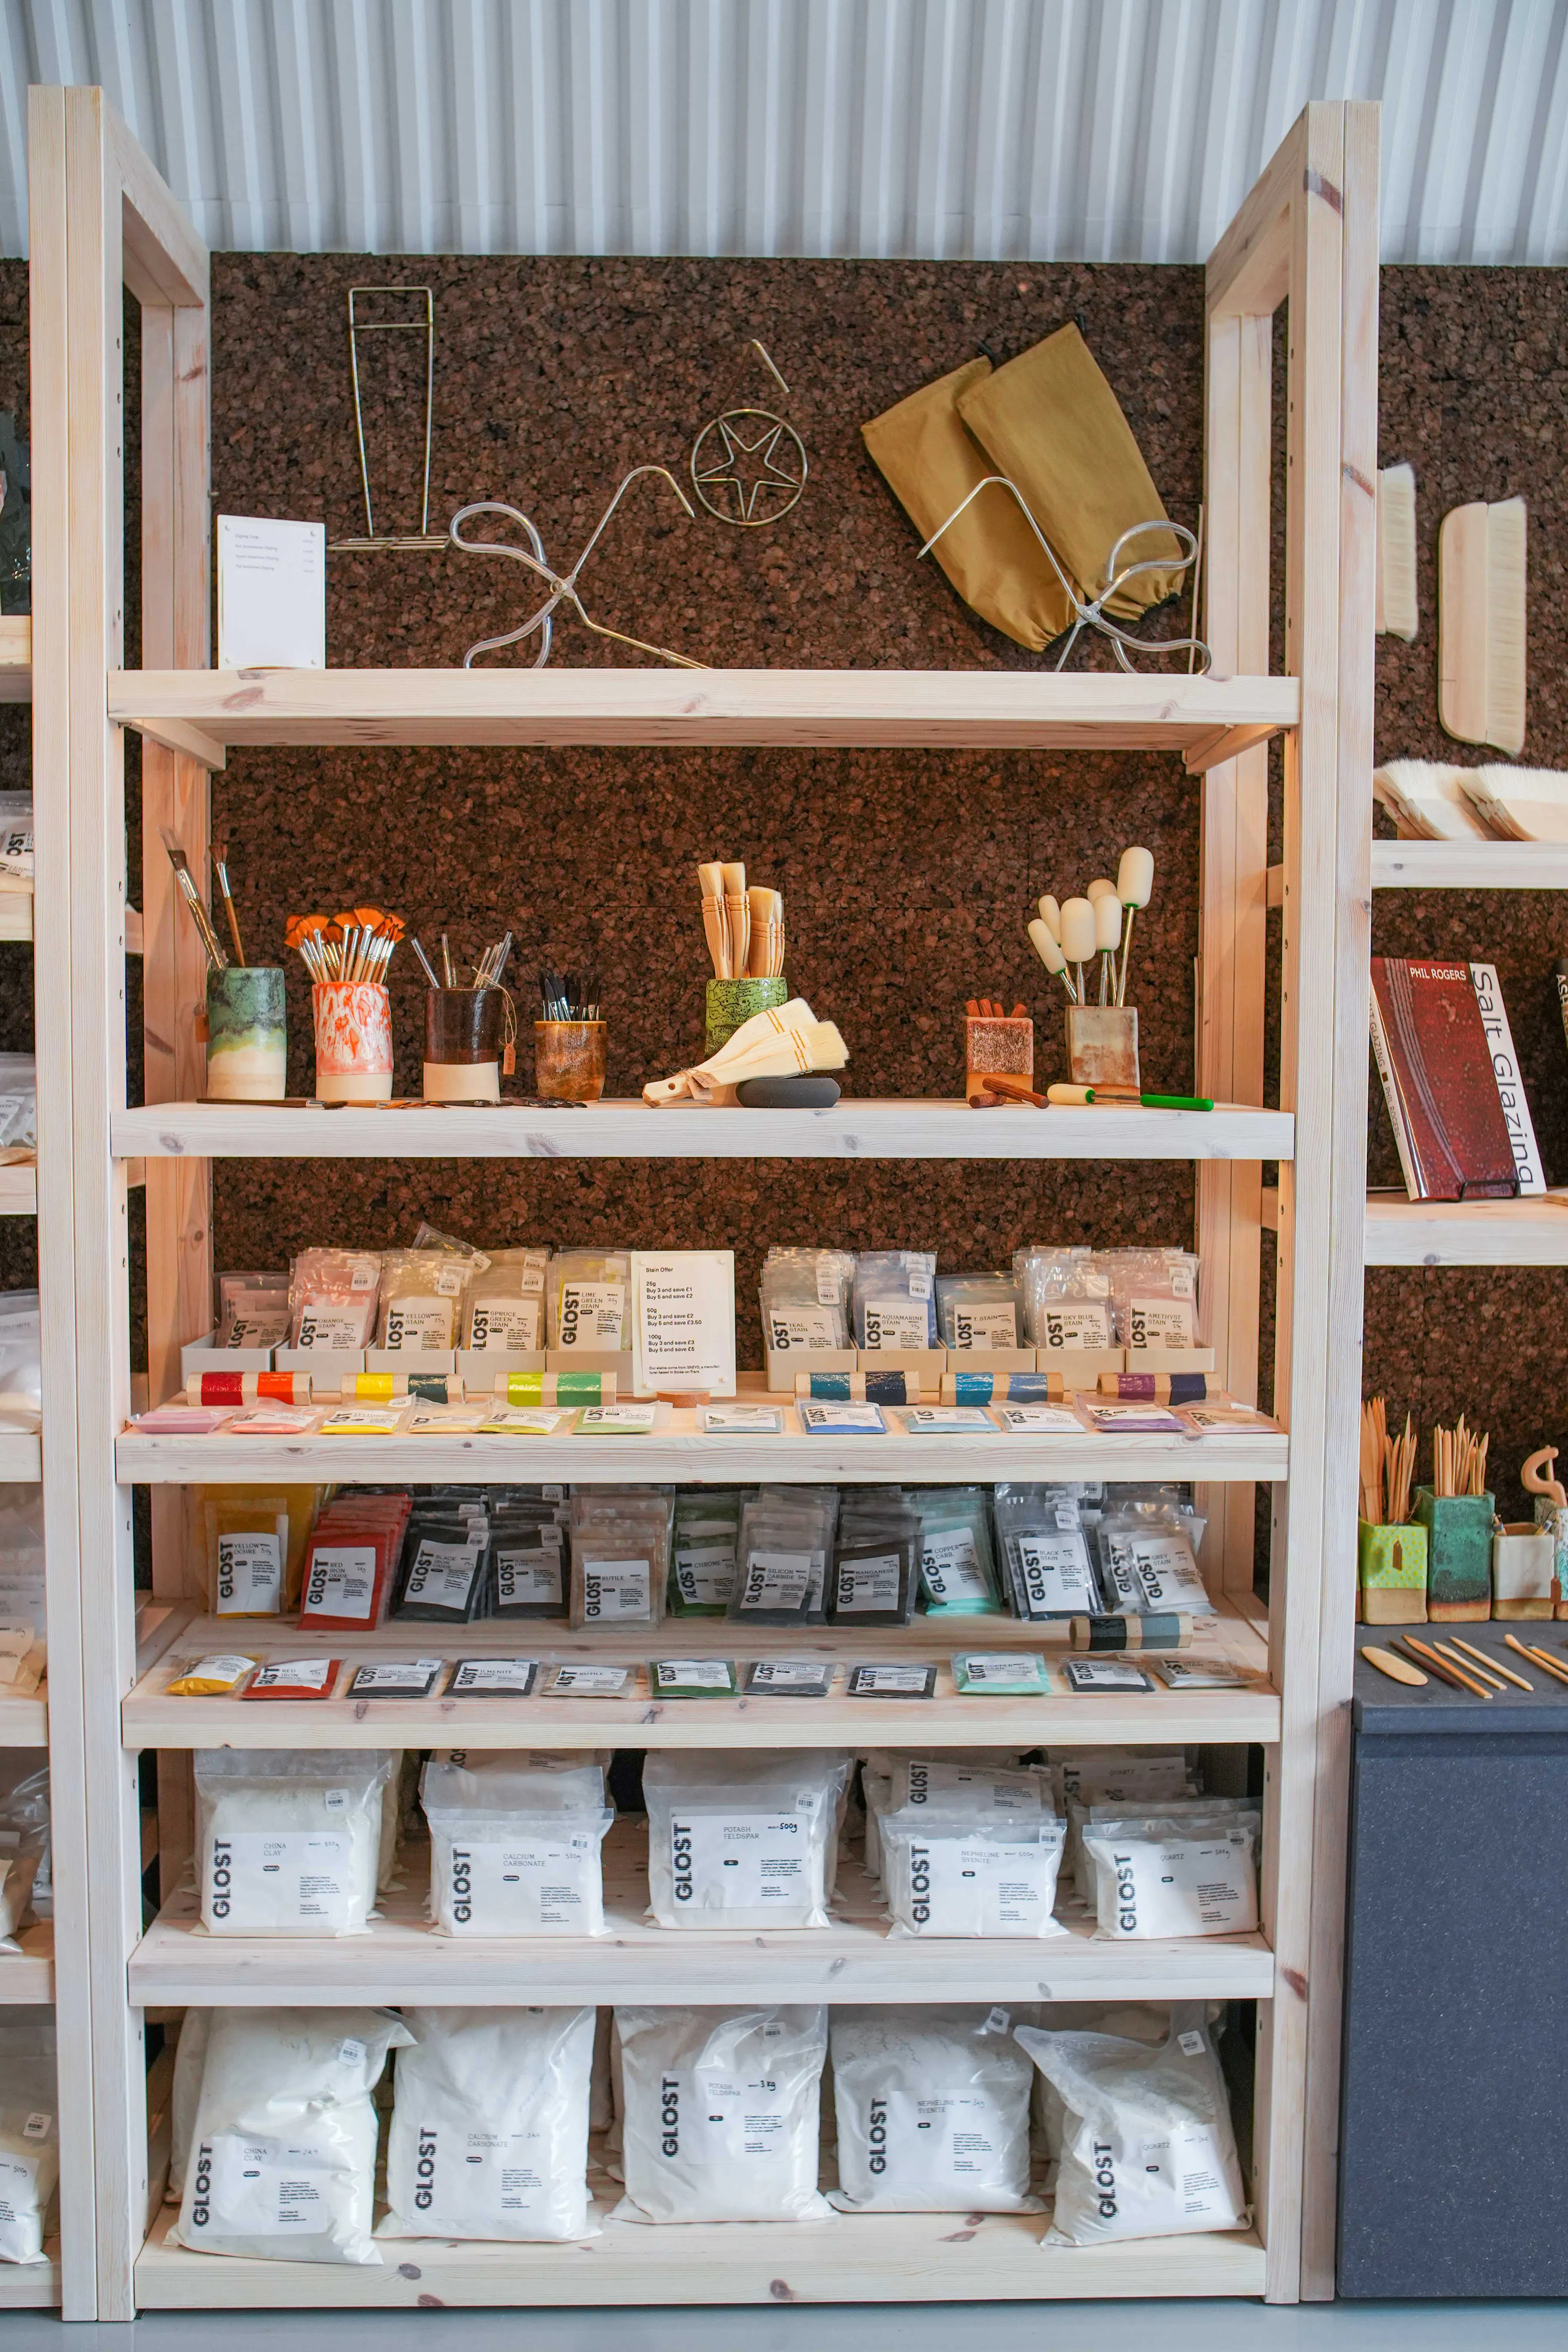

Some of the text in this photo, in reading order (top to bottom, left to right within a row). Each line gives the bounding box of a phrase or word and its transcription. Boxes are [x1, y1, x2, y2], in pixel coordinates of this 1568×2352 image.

[1410, 967, 1467, 981] PHIL ROGERS
[1370, 1022, 1385, 1067] GLAZING
[1389, 1106, 1400, 1138] ROGERS
[1472, 970, 1534, 1184] Salt Glazing
[561, 1289, 580, 1345] GLOST
[219, 1541, 234, 1598] GLOST
[410, 1549, 434, 1592] GLOST
[694, 1560, 721, 1568] CHROME
[923, 1548, 947, 1594] GLOST
[934, 1544, 959, 1554] COPPER
[309, 1559, 329, 1605] GLOST
[499, 1558, 515, 1596] GLOST
[586, 1572, 601, 1616] GLOST
[679, 1561, 698, 1599] GLOST
[745, 1563, 766, 1603] GLOST
[839, 1568, 855, 1604] GLOST
[1024, 1548, 1046, 1601] GLOST
[1136, 1554, 1163, 1599] GLOST
[457, 1666, 479, 1685] GLOST
[757, 1664, 776, 1680] GLOST
[1074, 1664, 1094, 1679] GLOST
[909, 1763, 929, 1804] GLOST
[780, 1823, 797, 1833] 500g
[212, 1838, 233, 1919] GLOST
[565, 1853, 581, 1862] 500g
[673, 1822, 693, 1901] GLOST
[1160, 1853, 1185, 1861] QUARTZ
[452, 1847, 472, 1924] GLOST
[911, 1844, 931, 1924] GLOST
[1114, 1853, 1138, 1932] GLOST
[661, 2077, 680, 2158] GLOST
[868, 2098, 888, 2175] GLOST
[1143, 2141, 1171, 2151] QUARTZ
[192, 2142, 214, 2228] GLOST
[414, 2127, 438, 2211] GLOST
[1093, 2140, 1119, 2219] GLOST
